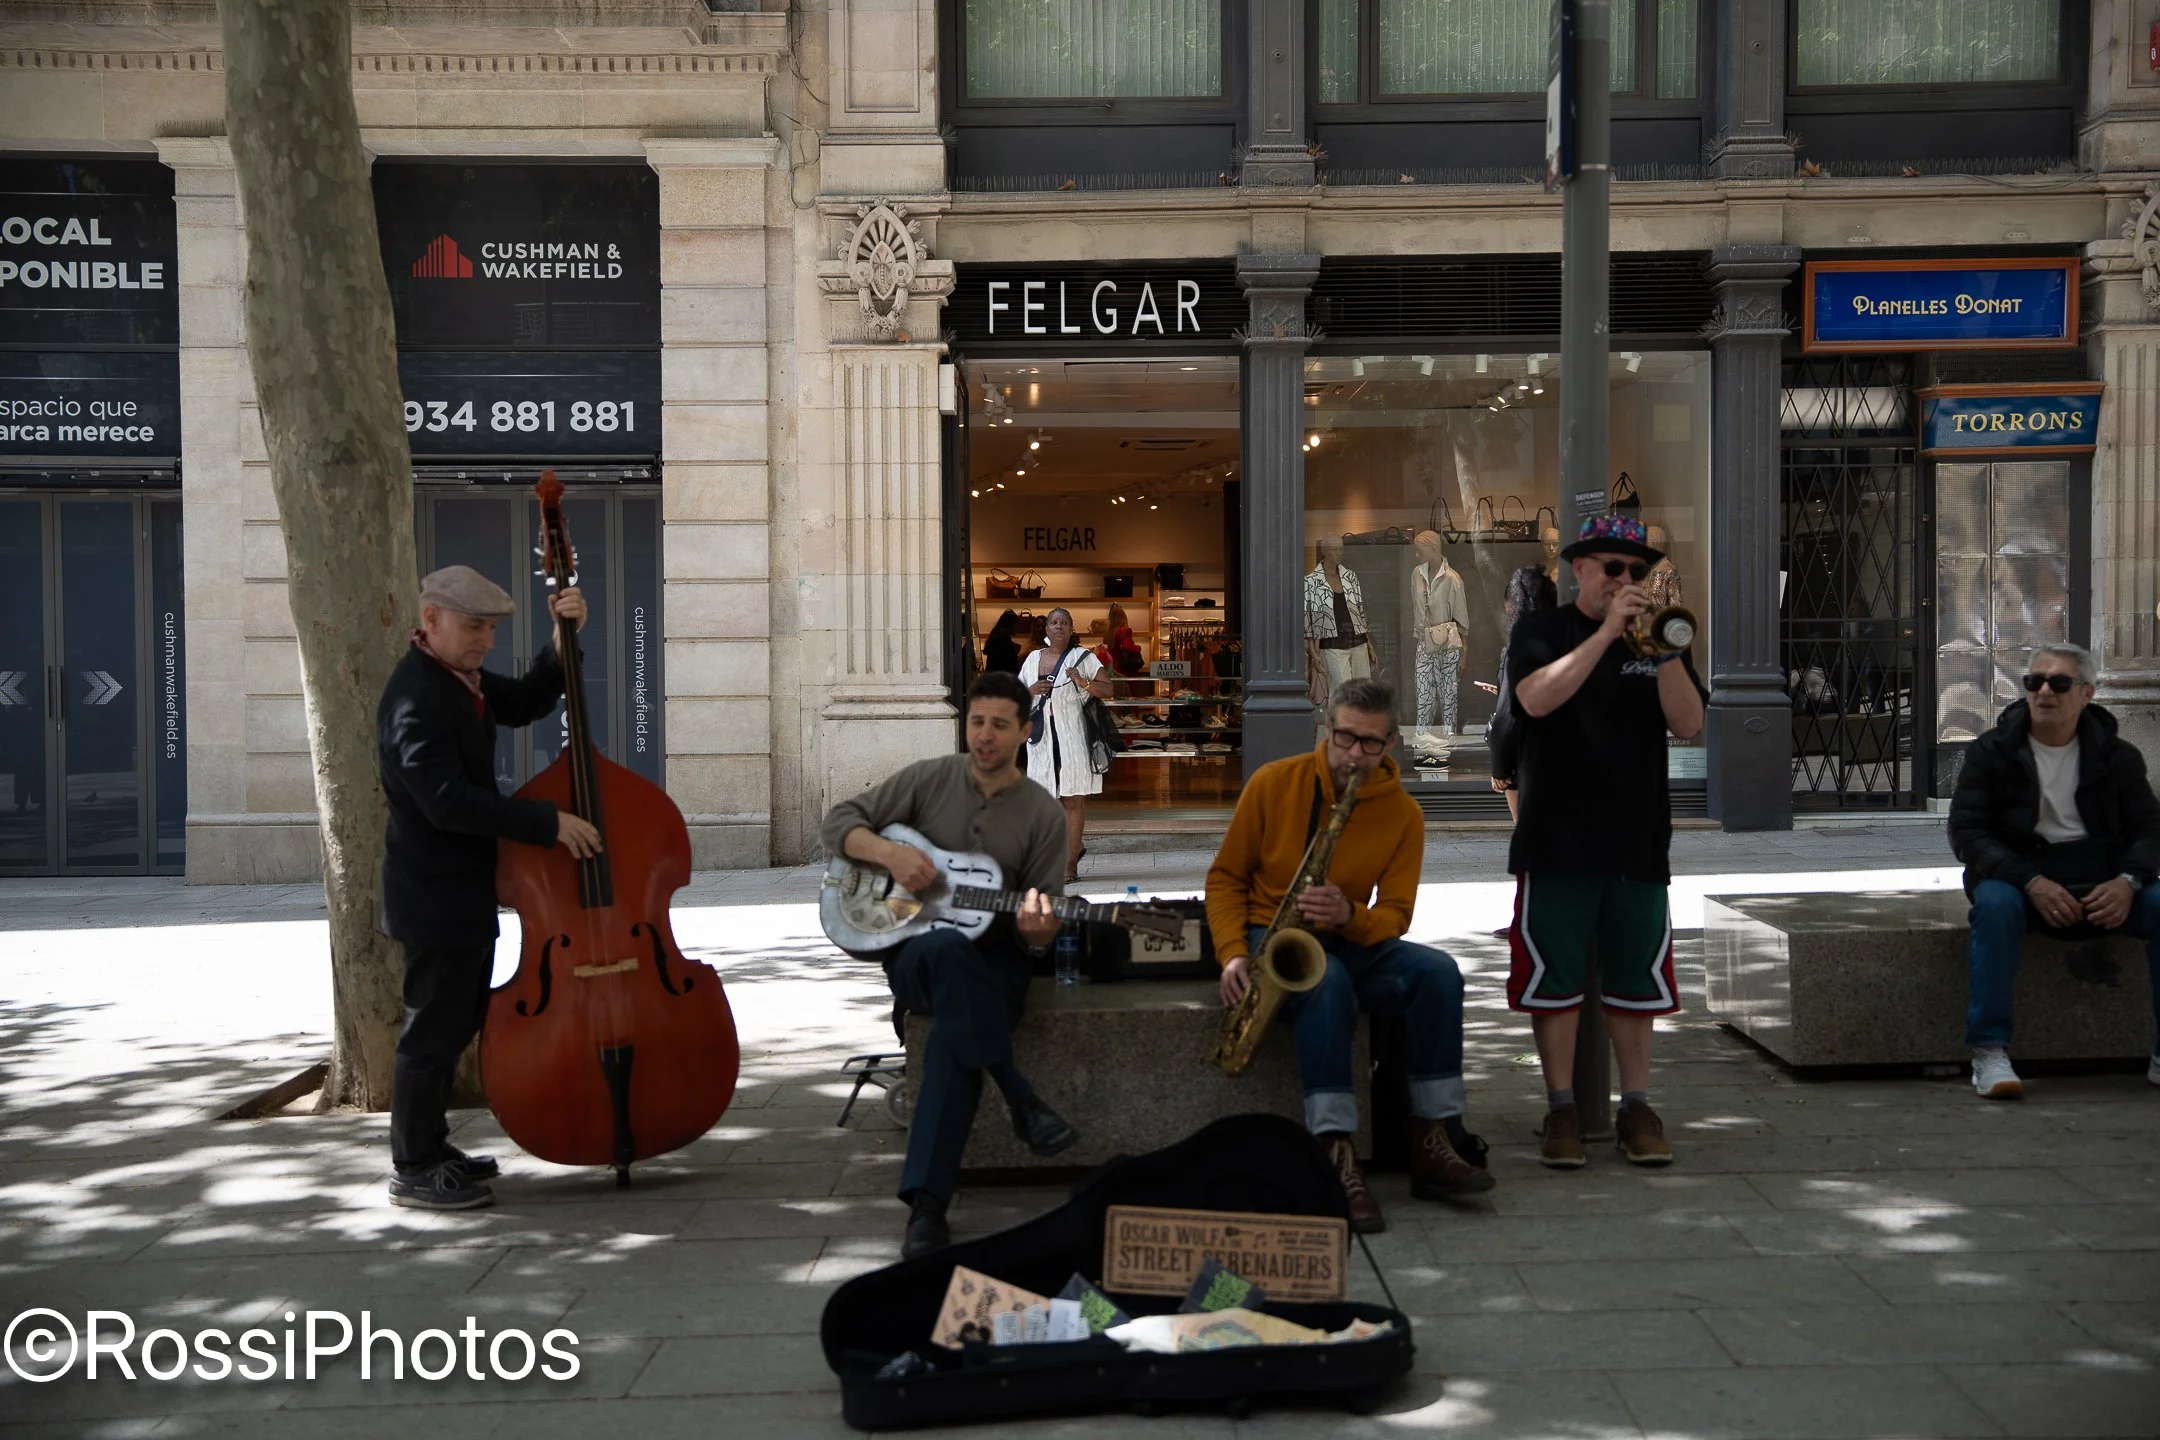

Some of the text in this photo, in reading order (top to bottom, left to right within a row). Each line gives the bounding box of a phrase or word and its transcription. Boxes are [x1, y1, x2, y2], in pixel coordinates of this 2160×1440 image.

[0, 216, 112, 246] OCAL
[481, 242, 622, 260] CUSHMAN &
[481, 262, 623, 279] WAKEFIELD
[988, 279, 1201, 335] FELGAR
[0, 395, 138, 421] spacio que
[402, 400, 634, 432] 934 881 881
[0, 424, 155, 442] arca merece
[1951, 411, 2083, 433] TORRONS
[1023, 526, 1096, 552] FELGAR
[634, 606, 648, 753] cushmanwakefield.es
[1157, 663, 1184, 671] ALDO
[164, 612, 179, 759] cushmanwakefield.es
[1119, 1221, 1171, 1245] OSCAR
[1117, 1244, 1194, 1273] STREET
